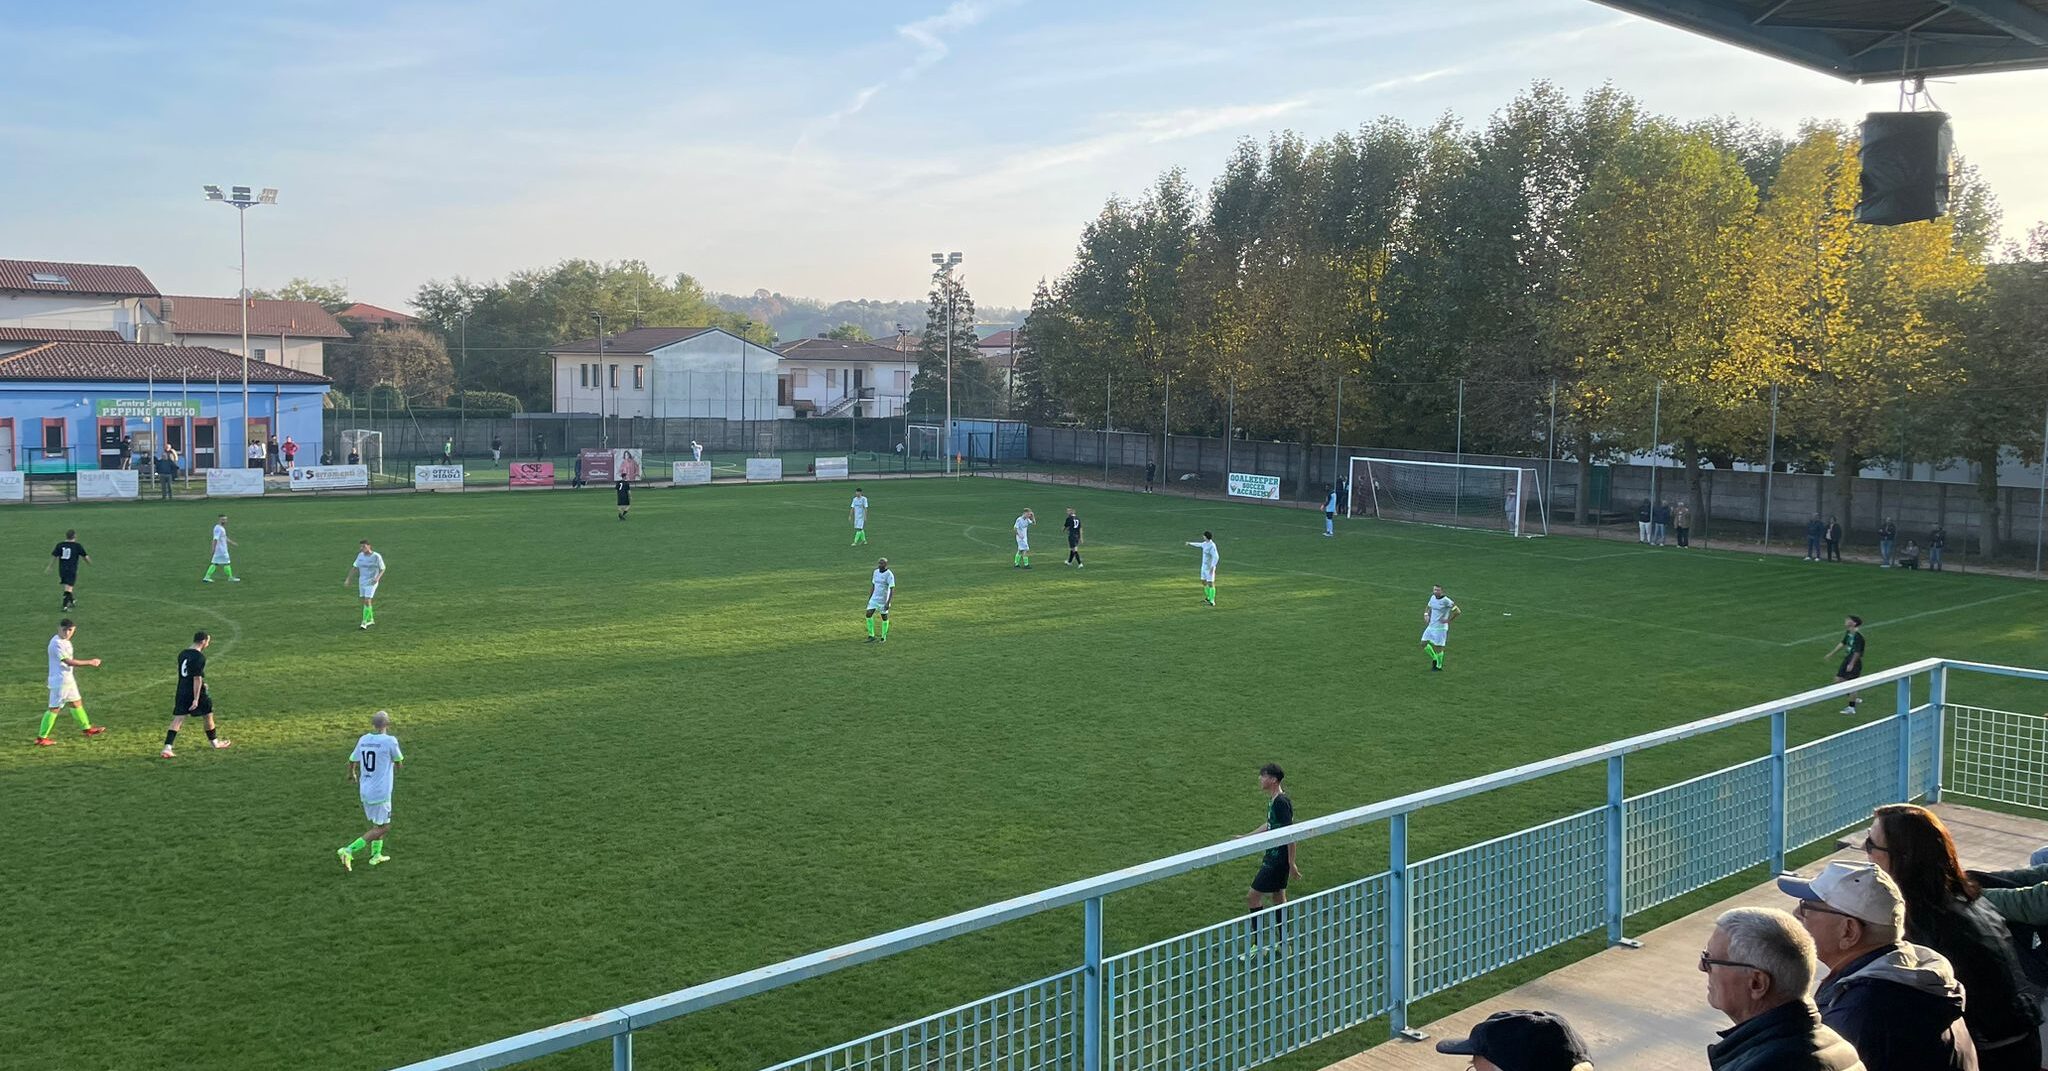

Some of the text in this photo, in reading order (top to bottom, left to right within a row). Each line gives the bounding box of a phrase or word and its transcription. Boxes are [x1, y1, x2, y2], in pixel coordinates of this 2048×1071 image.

[116, 399, 182, 409] Centro Sportivo
[102, 407, 195, 416] PEPPINO PRISCO
[520, 464, 542, 473] CSE
[1230, 474, 1279, 485] GOALKEEPER
[1242, 482, 1266, 491] SOCCER
[181, 658, 188, 677] 6
[362, 750, 376, 772] 10
